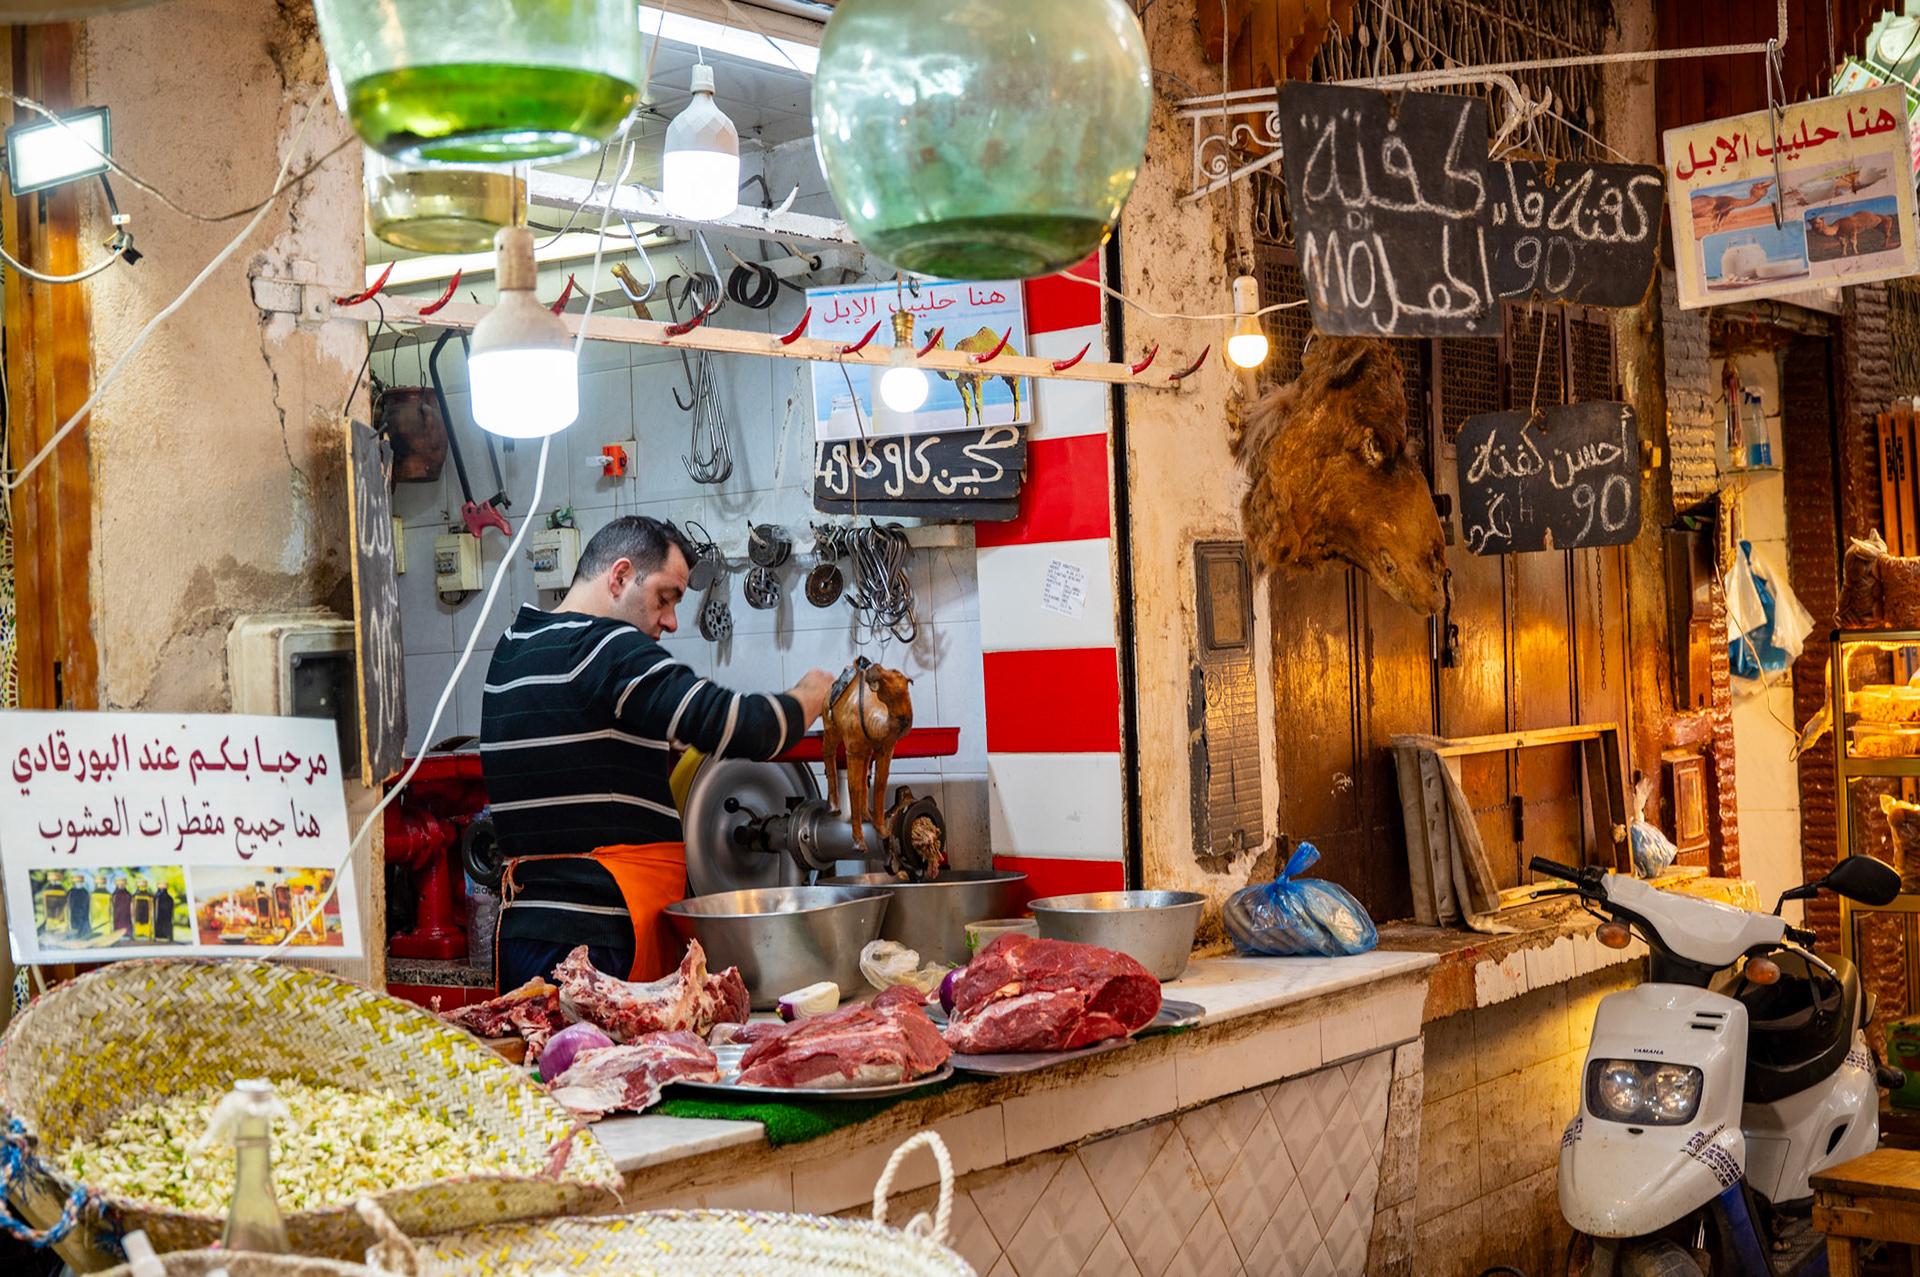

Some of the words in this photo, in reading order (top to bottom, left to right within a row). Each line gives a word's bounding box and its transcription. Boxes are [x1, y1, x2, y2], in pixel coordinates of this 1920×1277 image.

[1755, 119, 1839, 162] حليب
[1847, 106, 1896, 139] هنا
[1499, 236, 1576, 294] 90
[968, 287, 1006, 306] هنا
[1572, 473, 1632, 549] 90
[12, 730, 130, 796] البورقادي
[138, 738, 180, 771] عند
[188, 735, 250, 785] بكم
[254, 735, 327, 785] مرحبا
[39, 796, 130, 854] العشوب
[139, 796, 225, 851] مقطرات
[233, 818, 285, 860] جميع
[290, 798, 321, 838] هنا
